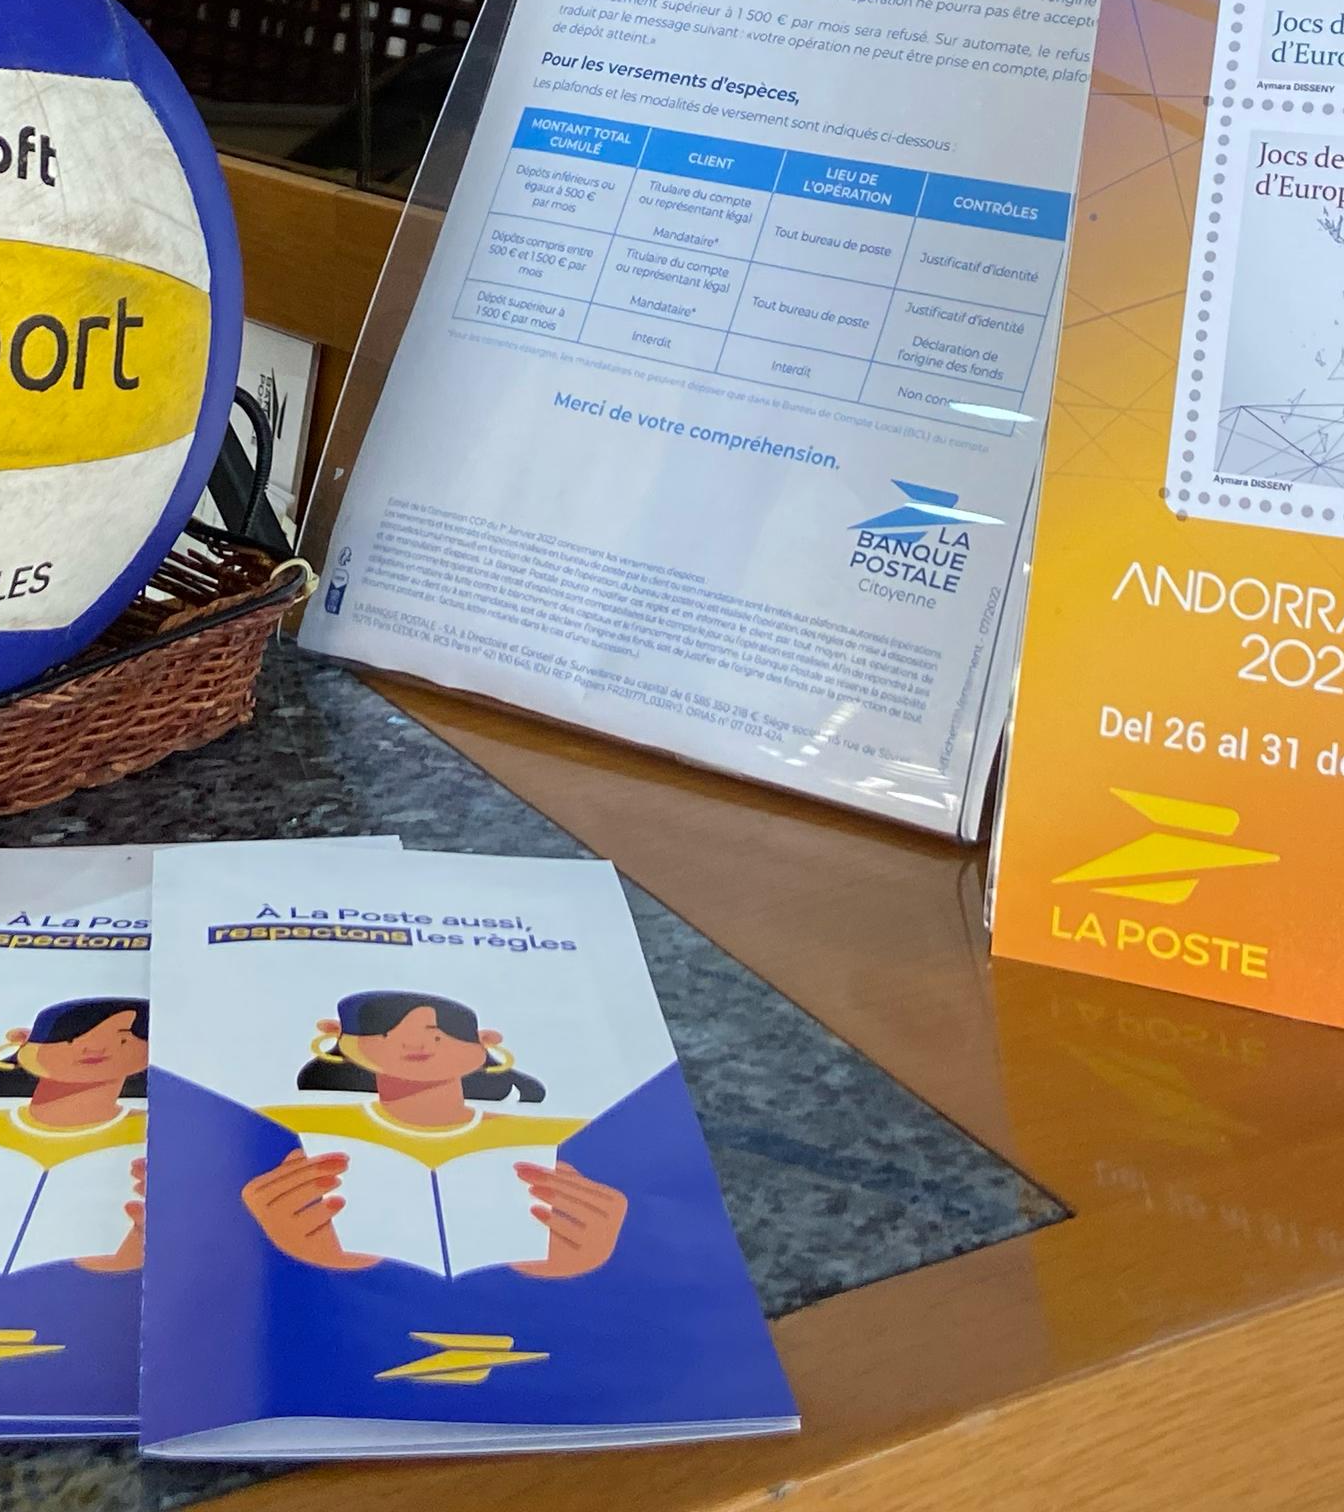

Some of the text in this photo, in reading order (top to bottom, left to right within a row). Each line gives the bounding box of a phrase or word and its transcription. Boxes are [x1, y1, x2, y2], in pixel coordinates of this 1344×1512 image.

[1272, 10, 1323, 36] Jocs
[541, 51, 800, 106] Pour les versements d'espèces,
[1257, 81, 1334, 93] Aymara DISSENY
[534, 77, 951, 151] Les plafonds et les modalités de versement sont indiqués ci-dessous
[532, 119, 632, 144] MONTANT TOTAL
[550, 136, 603, 155] CUMULÉ
[1256, 141, 1307, 169] Jocs
[688, 153, 734, 169] CLIENT
[826, 168, 879, 186] LIEU DE
[804, 180, 892, 205] L'OPÉRATION
[954, 196, 1039, 220] CONTRÔLES
[920, 252, 1038, 282] Justificatif d'identité
[772, 360, 812, 378] Interdit
[554, 392, 606, 416] Merci
[610, 404, 632, 422] de
[638, 414, 684, 434] votre
[690, 426, 840, 470] compréhension.
[1213, 473, 1293, 493] Aymara DISSENY
[857, 530, 967, 572] BANQUE
[939, 527, 970, 550] LA
[850, 551, 960, 593] POSTALE
[858, 578, 936, 608] Citoyenne
[1100, 705, 1152, 744] Del
[1165, 716, 1206, 752] 26
[1218, 727, 1249, 760] al
[1260, 734, 1300, 768] 31
[7, 910, 150, 931] À La Pos
[256, 903, 533, 931] À La Poste aussi,
[213, 925, 578, 953] respectons les règles
[1052, 906, 1268, 979] LA POSTE
